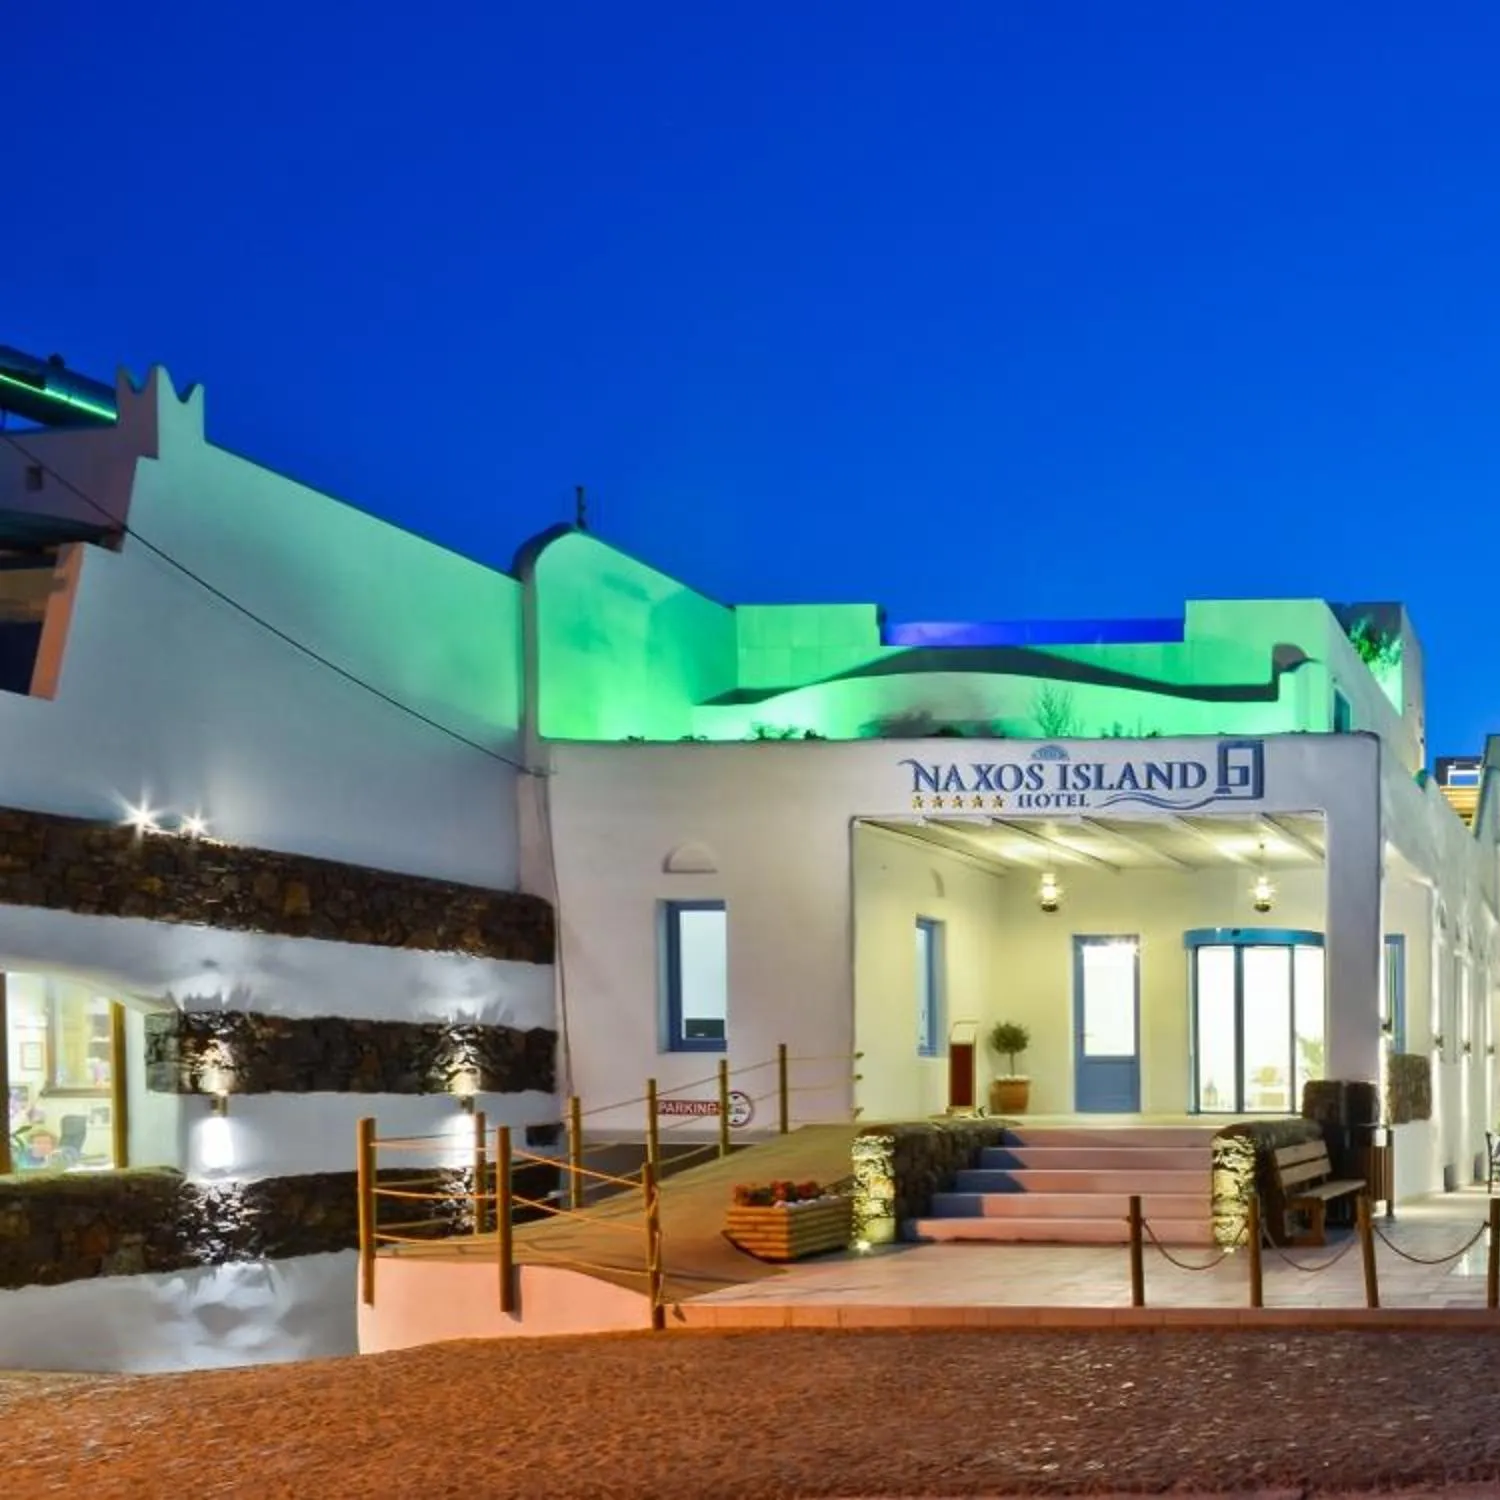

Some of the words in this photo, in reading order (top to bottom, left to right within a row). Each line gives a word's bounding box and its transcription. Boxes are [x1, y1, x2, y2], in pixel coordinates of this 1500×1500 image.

[898, 759, 1045, 792] NAXOS
[1059, 760, 1207, 791] ISLAND
[1016, 793, 1090, 809] HOTEL
[658, 1102, 718, 1114] PARKING
